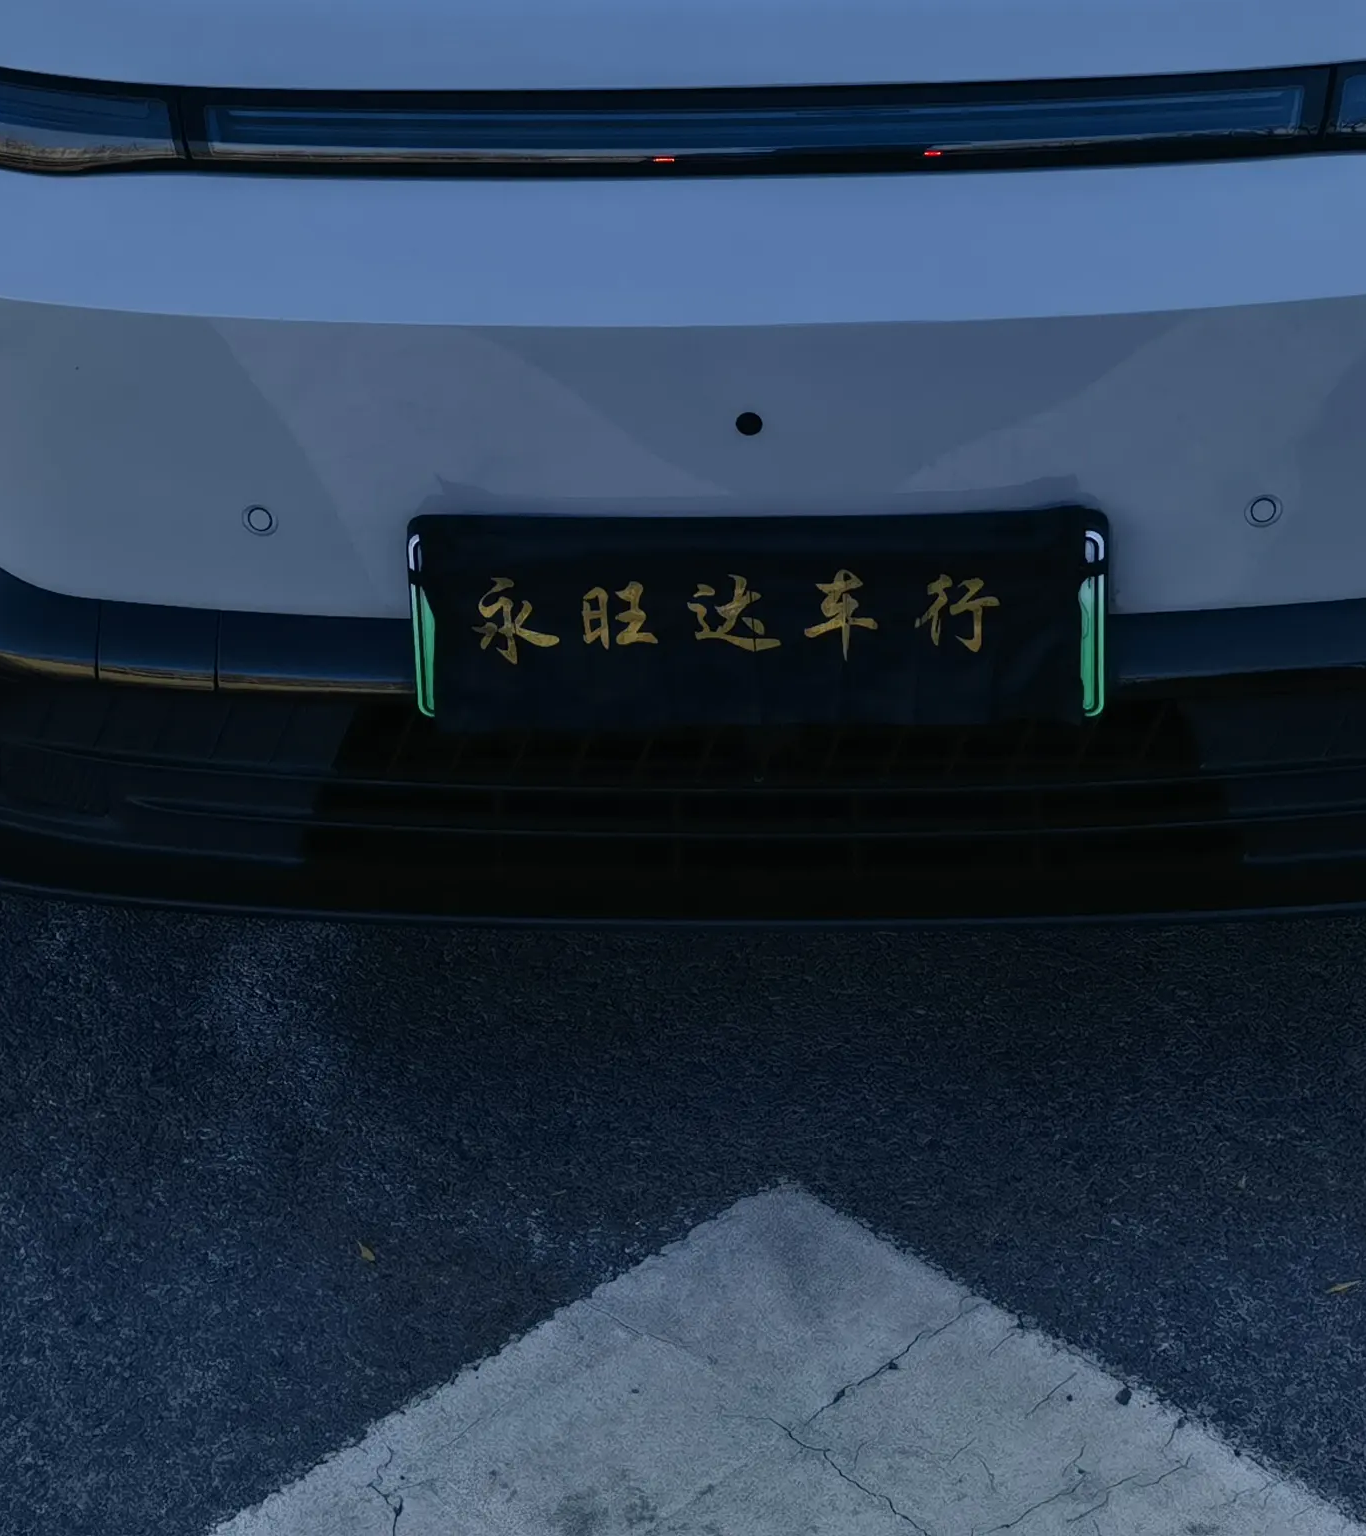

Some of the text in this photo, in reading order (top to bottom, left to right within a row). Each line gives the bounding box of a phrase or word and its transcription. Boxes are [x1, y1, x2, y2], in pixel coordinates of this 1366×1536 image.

[473, 569, 1001, 664] 永旺达车行
